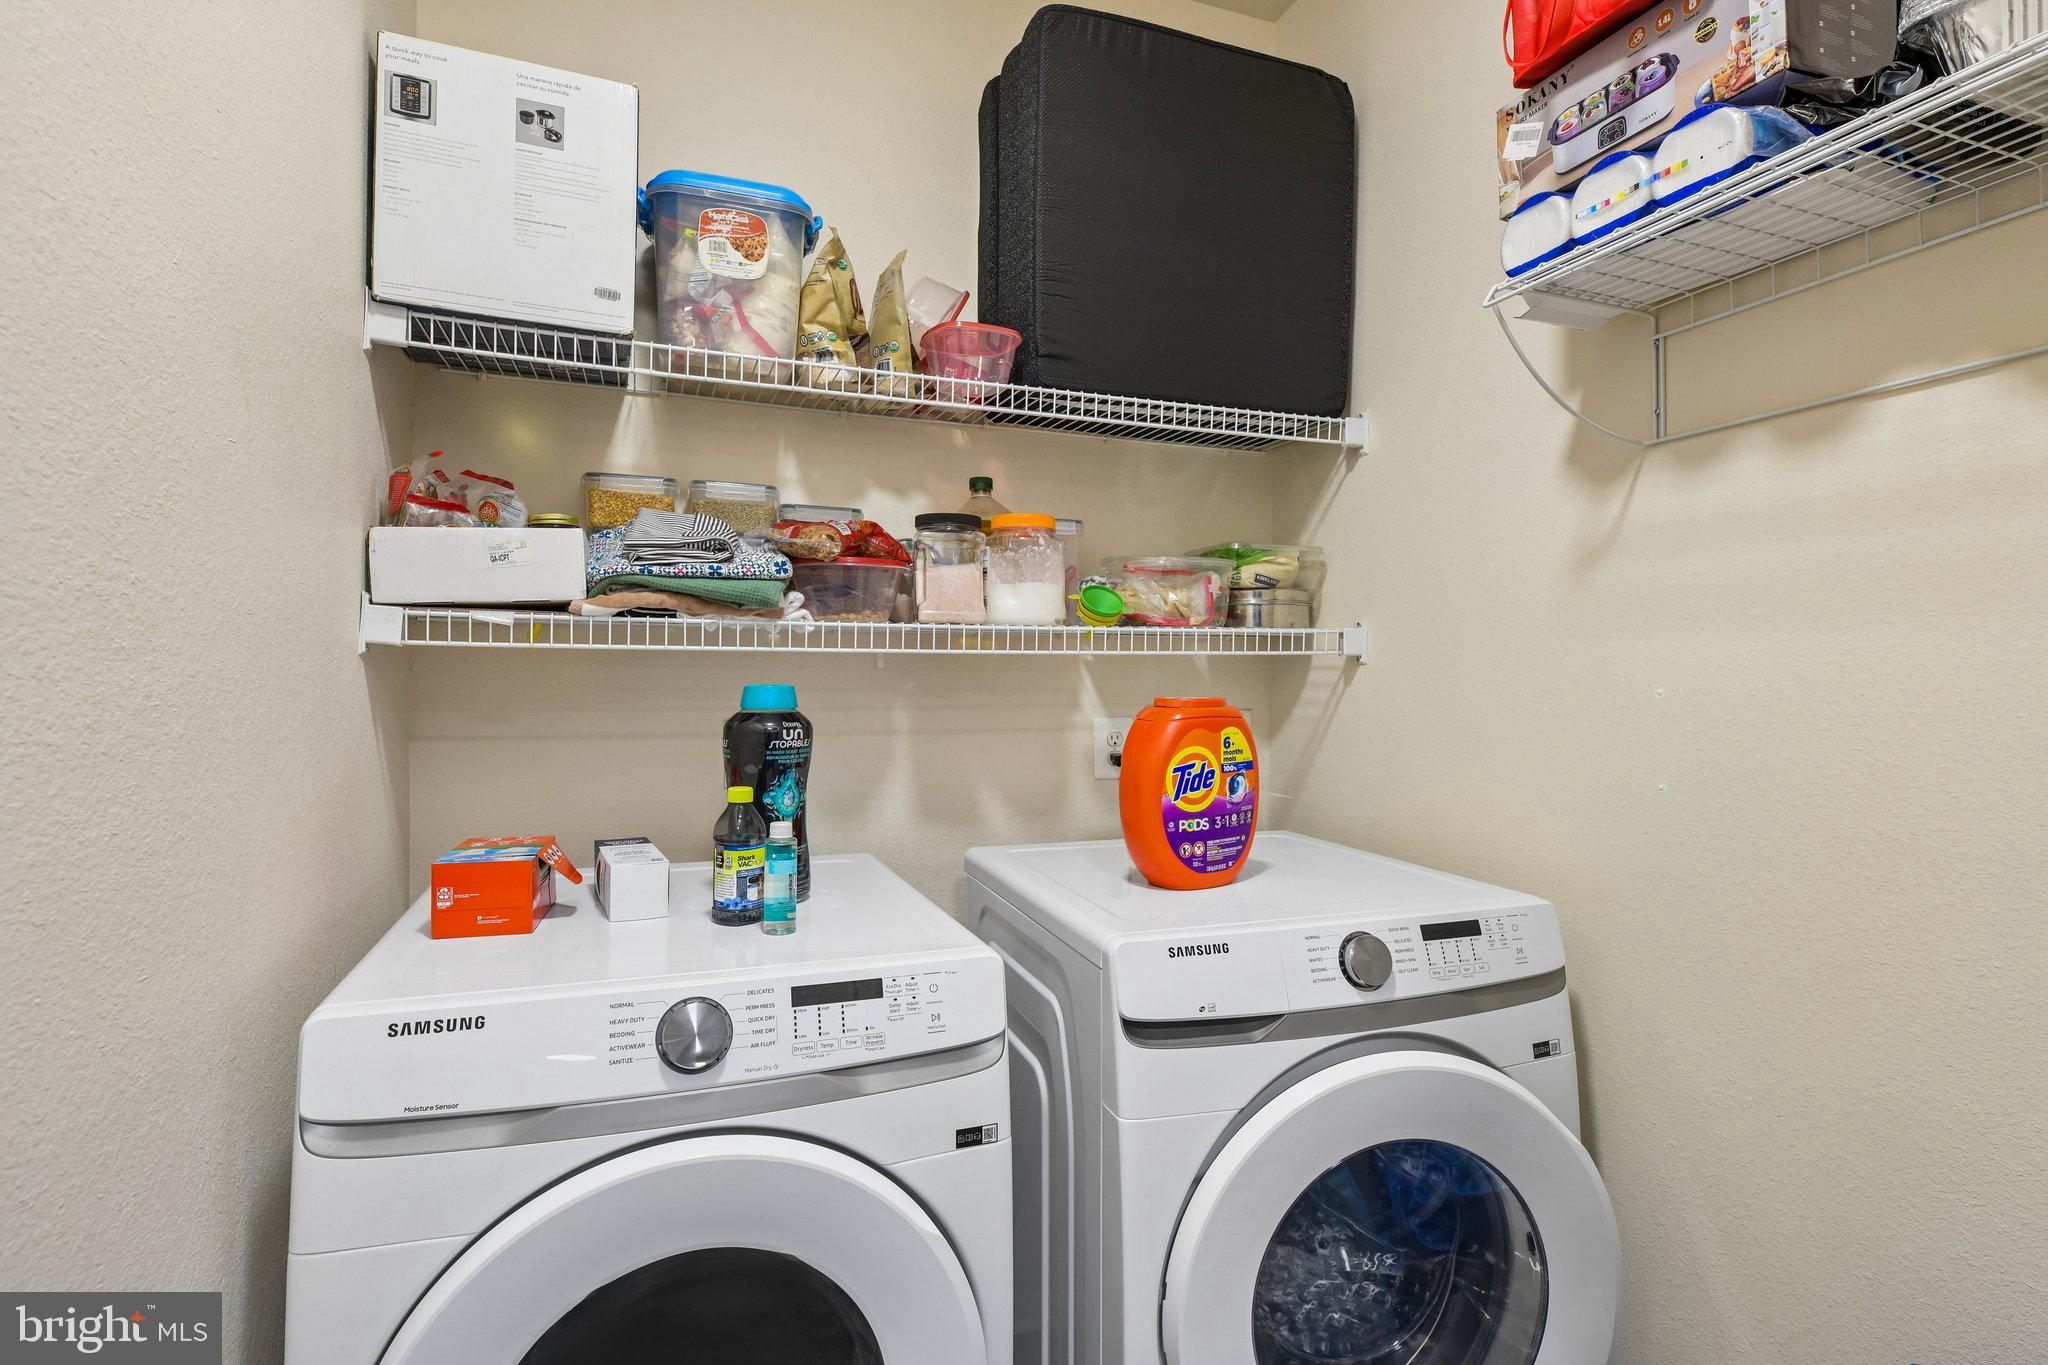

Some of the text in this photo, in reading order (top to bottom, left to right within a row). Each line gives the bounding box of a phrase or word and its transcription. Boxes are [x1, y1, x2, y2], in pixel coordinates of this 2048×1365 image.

[530, 76, 552, 84] manera
[1506, 69, 1570, 122] SOKANY
[1528, 101, 1549, 119] MAKER
[769, 738, 811, 748] STOPABLES
[1223, 748, 1243, 756] months
[1171, 760, 1217, 804] Tide
[1179, 818, 1210, 833] PODS
[1168, 943, 1229, 958] SAMSUNG
[747, 988, 775, 996] DELICATES
[609, 1002, 634, 1010] NORMAL
[609, 1016, 645, 1026] HEAVY DUTY
[387, 1015, 486, 1037] SAMSUNG
[609, 1031, 636, 1039] BEDDING
[609, 1043, 646, 1052] ACTIVEWEAR
[793, 1044, 814, 1053] Dryness
[744, 1064, 773, 1073] Manual Dry
[404, 1105, 434, 1113] Moisture
